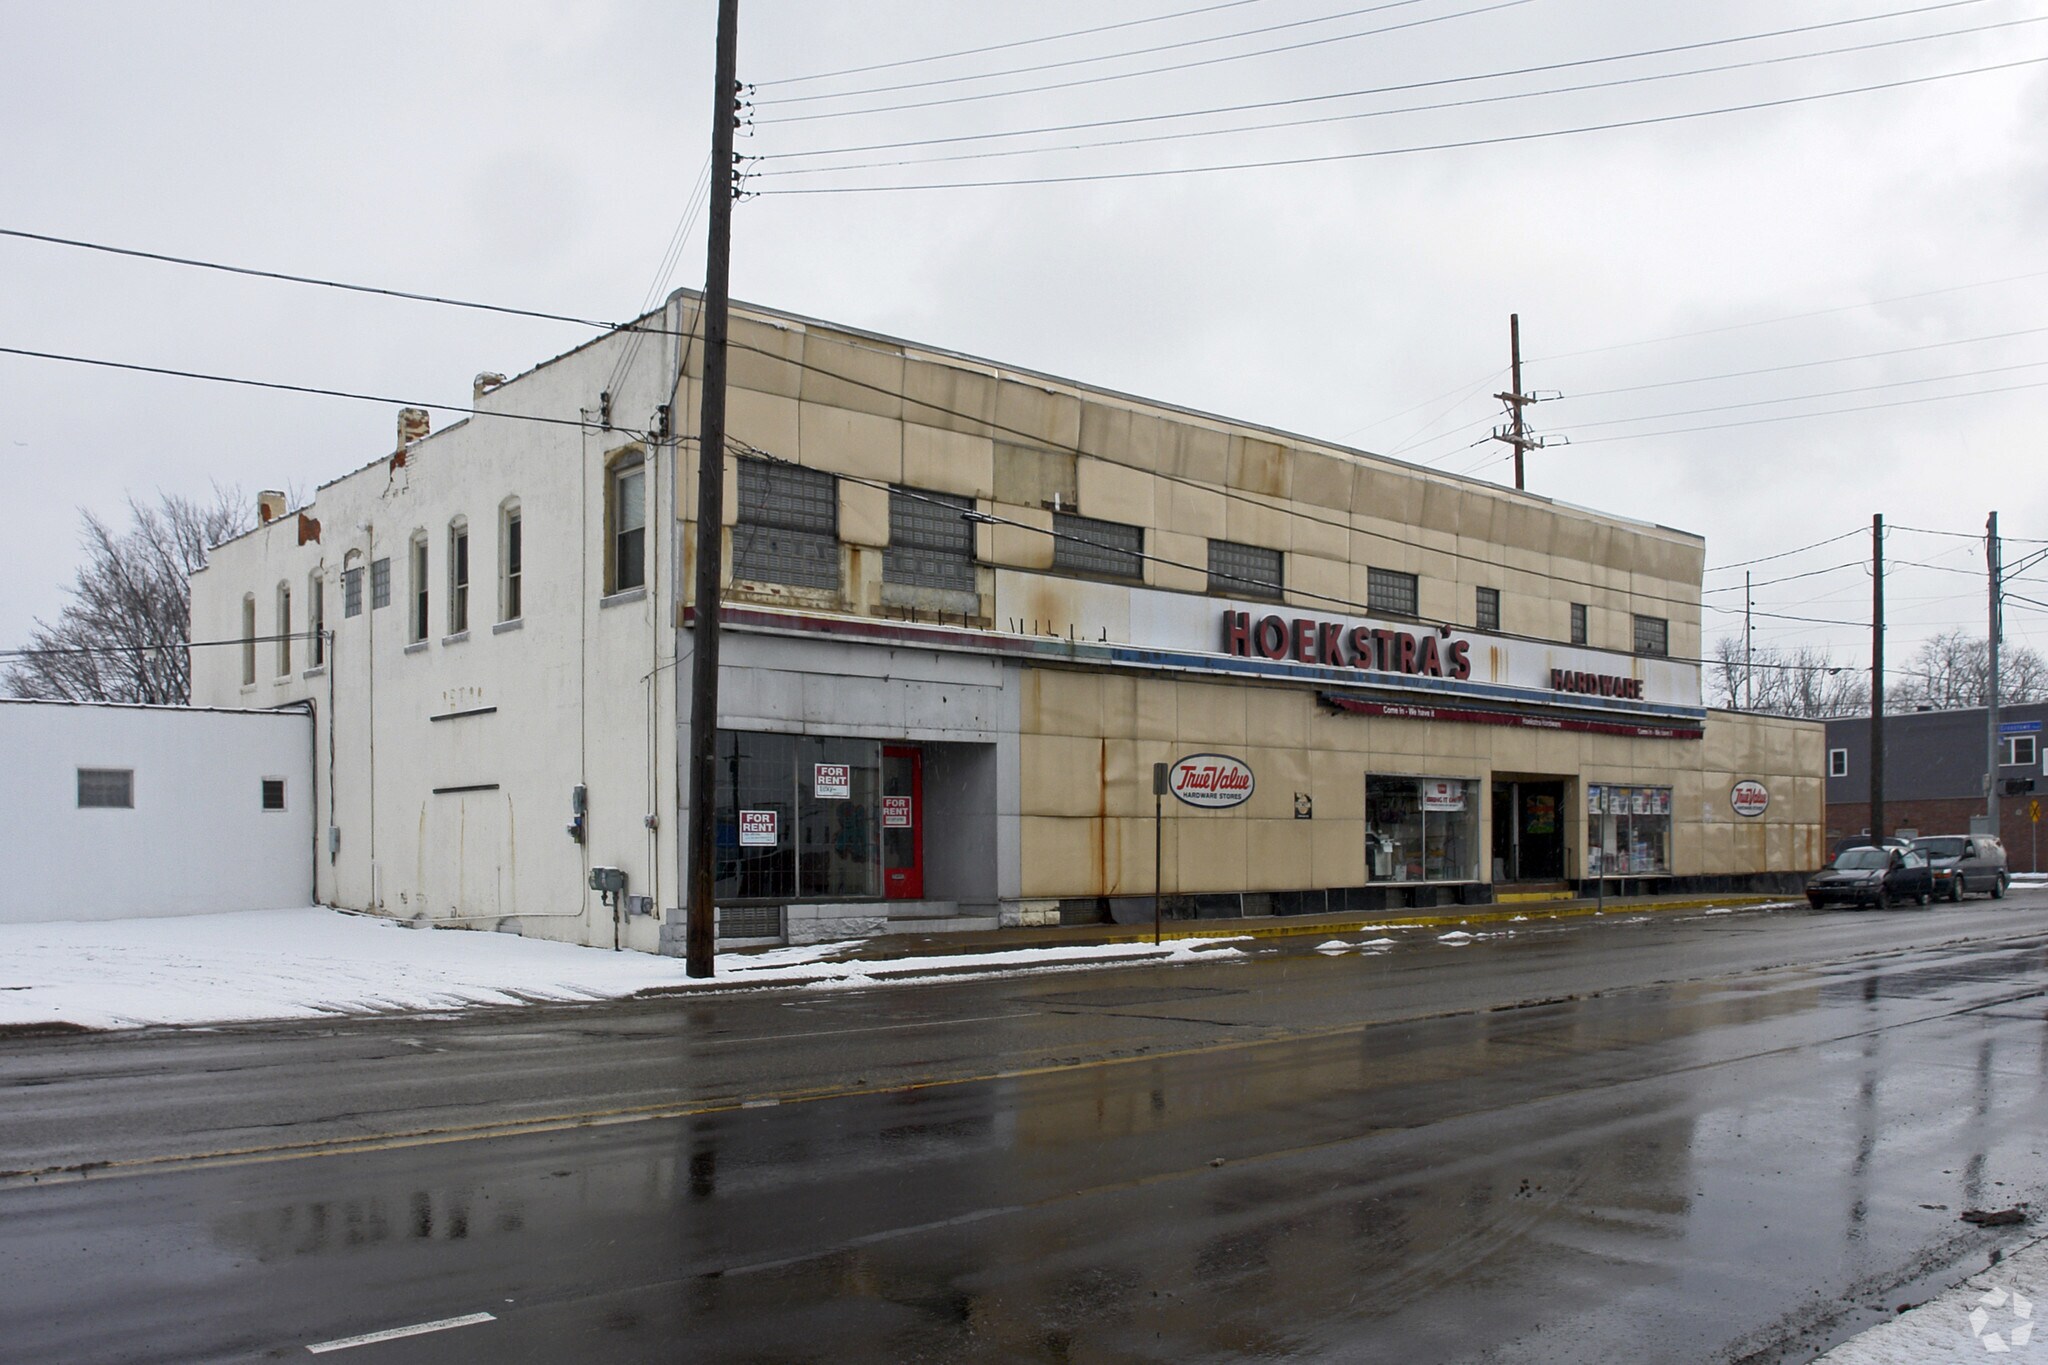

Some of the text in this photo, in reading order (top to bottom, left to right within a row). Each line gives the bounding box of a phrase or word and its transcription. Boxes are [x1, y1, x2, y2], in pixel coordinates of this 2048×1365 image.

[1222, 609, 1471, 680] HOEKSTRA'S
[1551, 668, 1645, 699] HARDWARE
[1383, 705, 1398, 714] Come
[1408, 708, 1417, 716] We
[1418, 709, 1430, 717] have
[821, 767, 843, 776] FOR
[818, 776, 846, 785] RENT
[1176, 765, 1249, 792] True Value
[1183, 791, 1218, 799] HARDWARE
[886, 799, 905, 807] FOR
[746, 814, 770, 823] FOR
[743, 823, 773, 831] RENT
